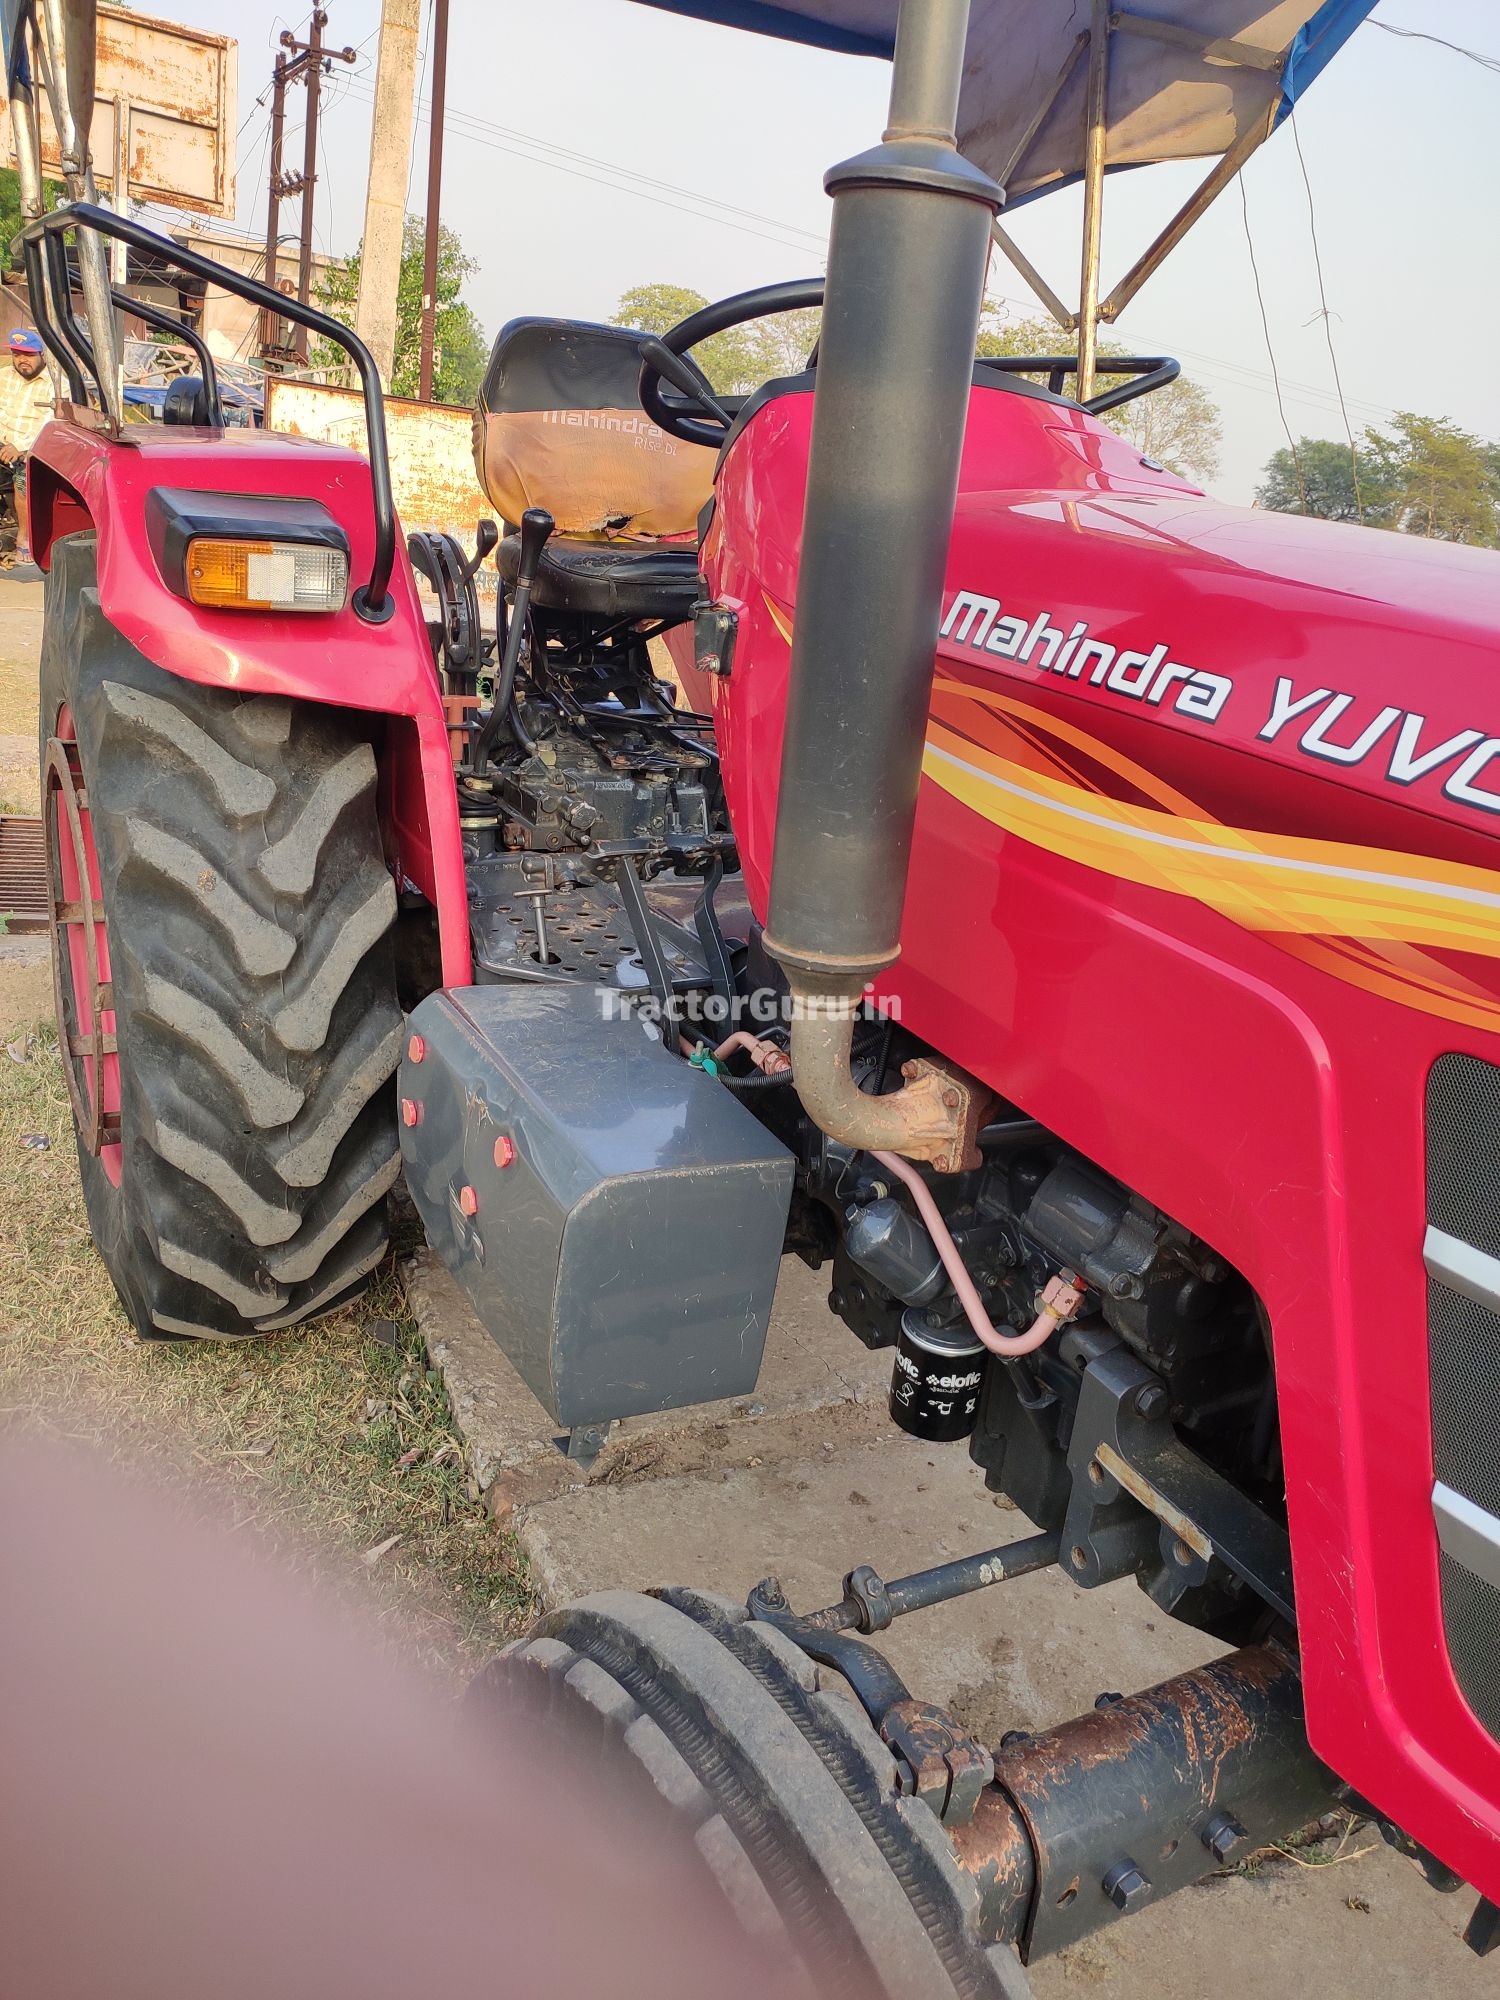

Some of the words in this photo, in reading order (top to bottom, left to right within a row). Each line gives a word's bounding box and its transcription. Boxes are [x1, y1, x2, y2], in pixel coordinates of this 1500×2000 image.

[938, 590, 1233, 724] Mahindra
[895, 1347, 919, 1378] lofic
[940, 1371, 982, 1388] elofic
